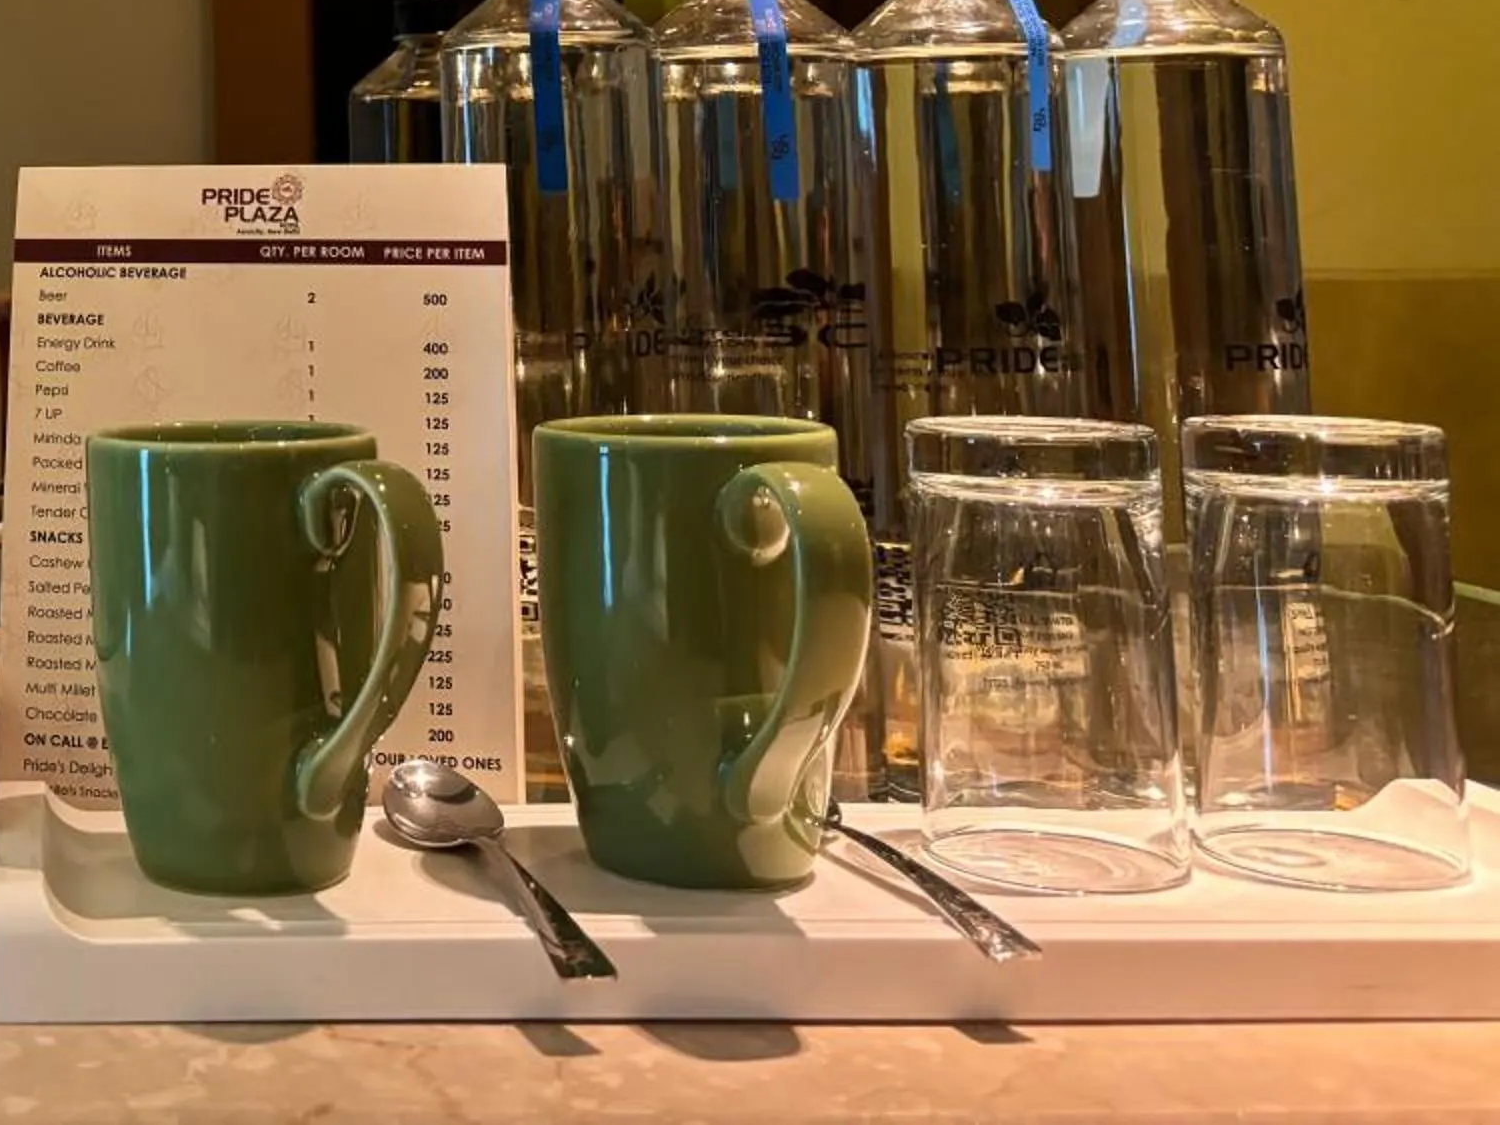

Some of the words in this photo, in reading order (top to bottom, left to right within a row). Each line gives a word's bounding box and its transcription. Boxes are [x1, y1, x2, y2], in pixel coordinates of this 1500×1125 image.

[202, 188, 271, 205] PRIDE
[225, 206, 299, 223] PLAZA
[97, 245, 132, 257] ITEMS
[260, 247, 289, 258] QTY.
[293, 247, 317, 258] PER
[321, 247, 365, 258] ROOM
[383, 247, 422, 259] PRICE
[427, 248, 450, 259] PER
[454, 248, 485, 260] ITEM
[40, 267, 116, 279] ALCOHOLIC
[119, 267, 187, 279] BEVERAGE
[38, 290, 67, 302] Beer
[307, 293, 316, 304] 2
[423, 294, 447, 306] 500
[38, 314, 104, 326] BEVERAGE
[37, 337, 80, 351] Energy
[84, 337, 116, 350] Drink
[308, 341, 314, 352] 1
[423, 343, 449, 355] 400
[566, 330, 664, 357] PIDE
[936, 347, 1059, 373] PRIDE
[35, 360, 81, 373] Coffee
[308, 365, 314, 376] 1
[423, 368, 449, 380] 200
[35, 384, 69, 397] Pepsi
[309, 389, 314, 401] 1
[425, 392, 449, 404] 125
[35, 409, 41, 419] 7
[45, 409, 63, 420] UP
[425, 418, 449, 430] 125
[33, 433, 82, 445] Mirinda
[426, 443, 450, 455] 125
[32, 457, 83, 470] Packed
[426, 468, 450, 481] 125
[31, 481, 81, 494] Mineral
[433, 494, 450, 506] 25
[31, 505, 76, 518] Tender
[80, 506, 88, 519] C
[29, 531, 83, 544] SNACKS
[29, 555, 84, 569] Cashew
[29, 580, 70, 594] Salted
[28, 606, 83, 620] Roasted
[28, 630, 82, 645] Roasted
[435, 626, 452, 637] 25
[27, 656, 81, 670] Roasted
[428, 652, 452, 663] 225
[429, 678, 453, 689] 125
[25, 683, 57, 695] Multi
[61, 684, 96, 697] Millet
[25, 707, 98, 723] Chocolate
[429, 704, 453, 716] 125
[24, 733, 46, 746] ON
[50, 734, 84, 748] CALL
[428, 730, 454, 742] 200
[23, 758, 64, 774] Pride's
[69, 760, 113, 778] Deligh
[375, 753, 405, 765] OUR
[462, 757, 502, 771] ONES
